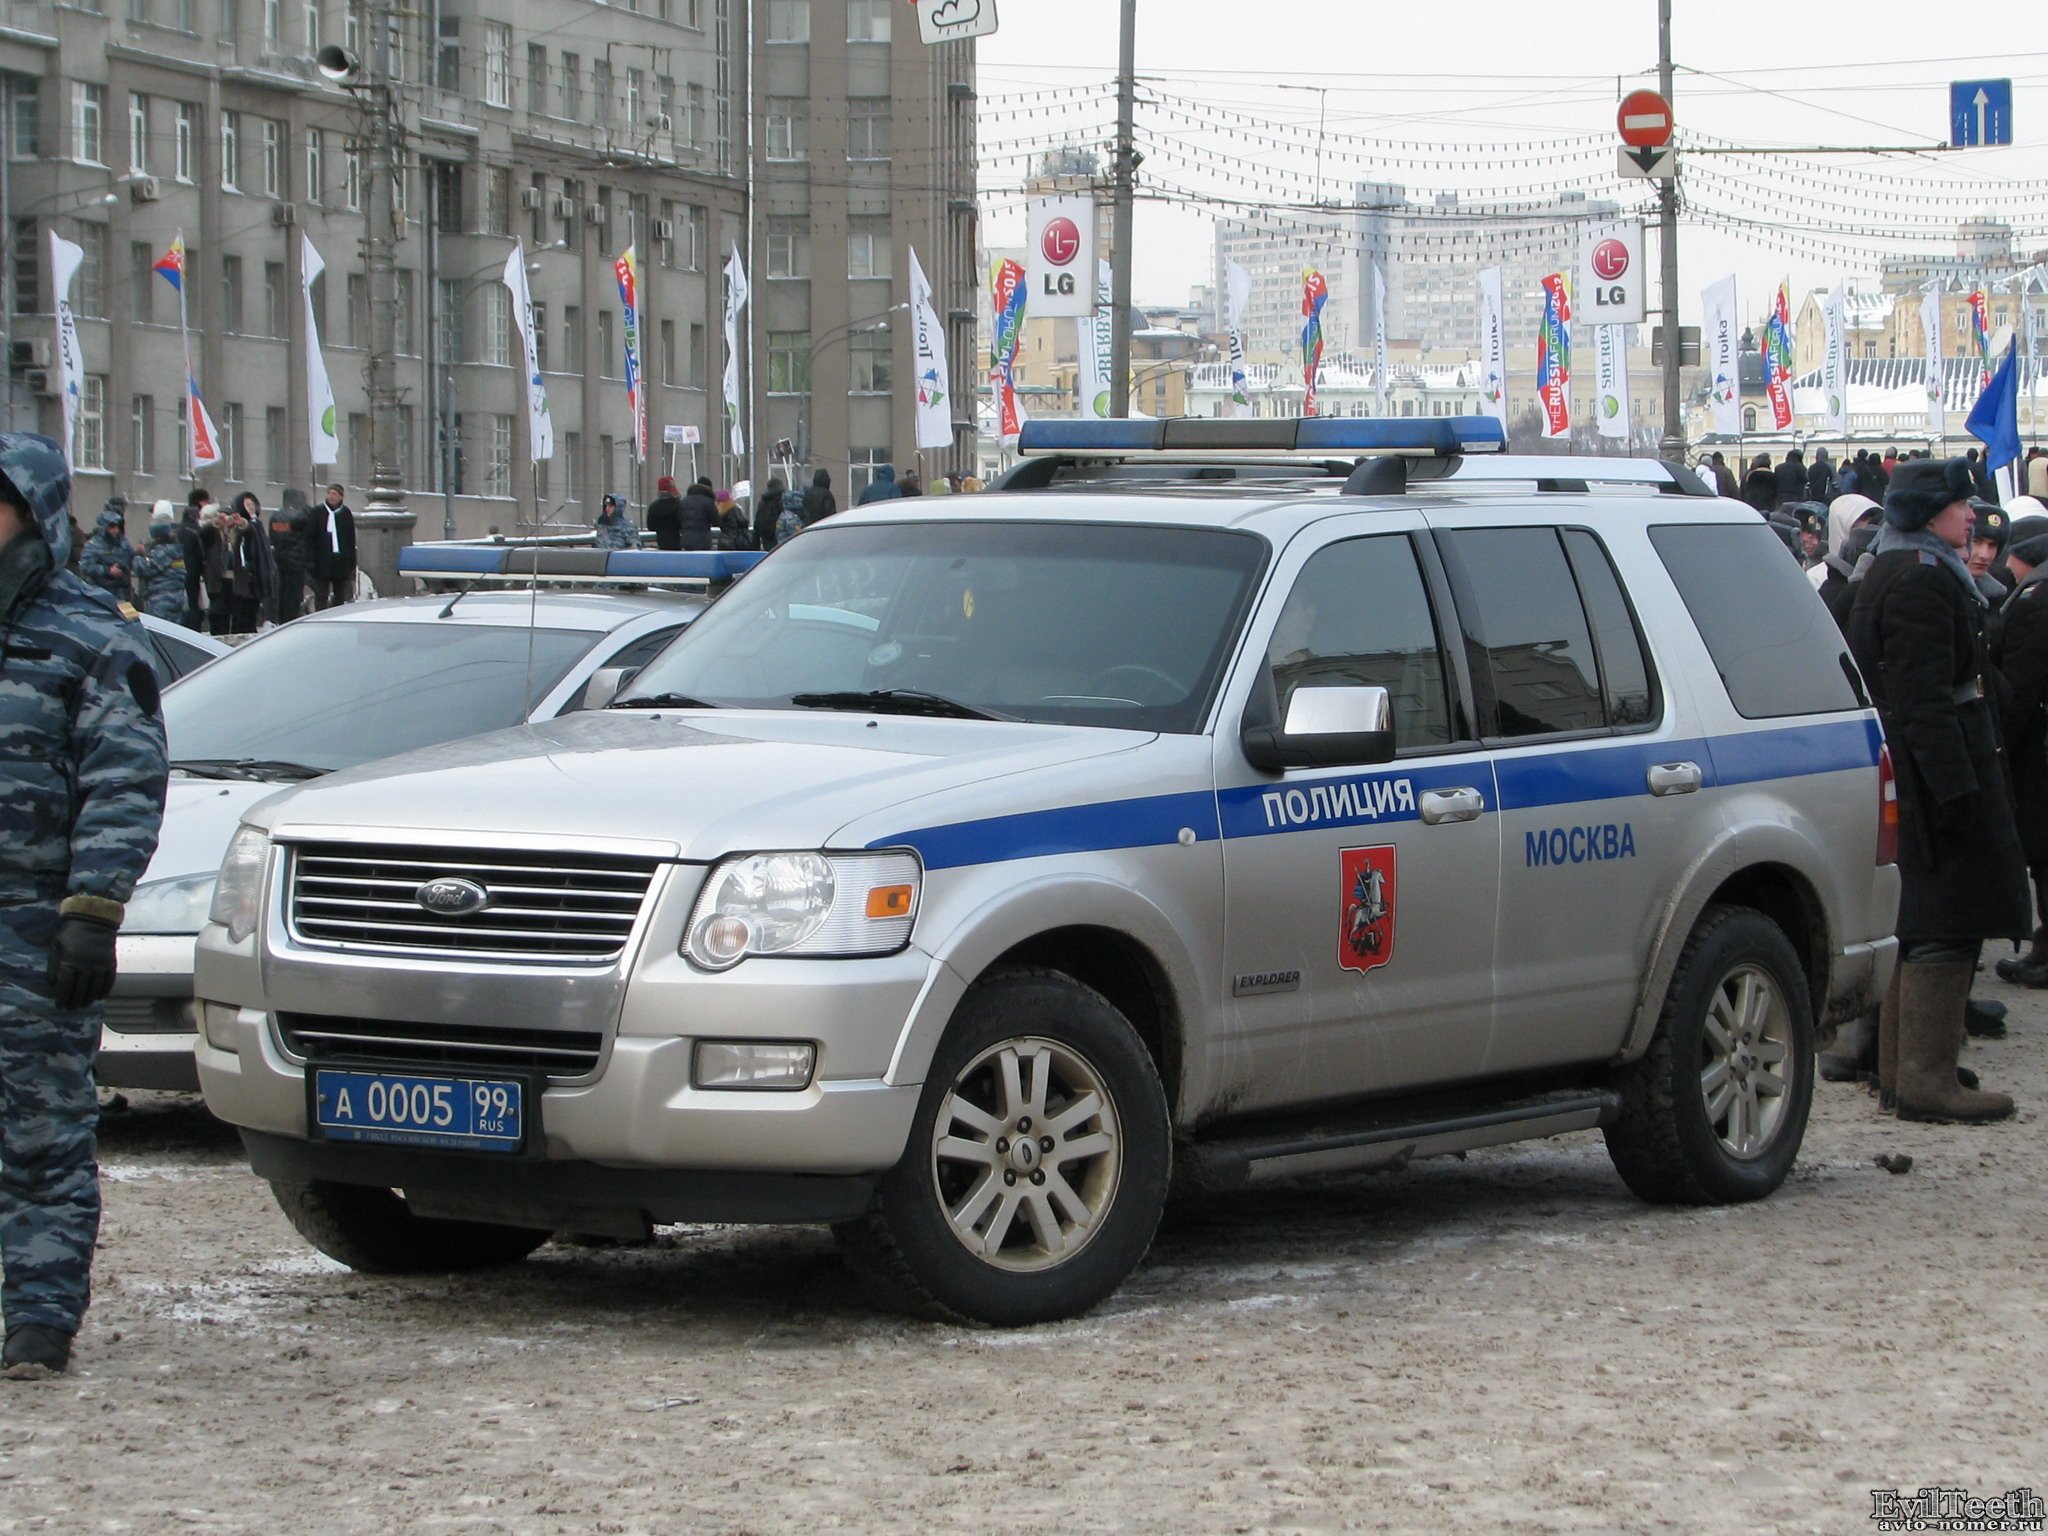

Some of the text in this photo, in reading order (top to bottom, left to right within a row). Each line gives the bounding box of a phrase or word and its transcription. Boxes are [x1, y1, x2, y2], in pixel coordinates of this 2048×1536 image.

[1043, 271, 1075, 296] LG
[1596, 286, 1626, 306] LG
[1262, 778, 1416, 828] ПОЛИЦИЯ
[1525, 822, 1637, 868] МОСКВА
[426, 884, 466, 906] Ford
[1240, 970, 1301, 989] EXPLORER
[368, 1081, 453, 1126] 0005
[475, 1086, 508, 1119] 99
[479, 1119, 505, 1133] RUS
